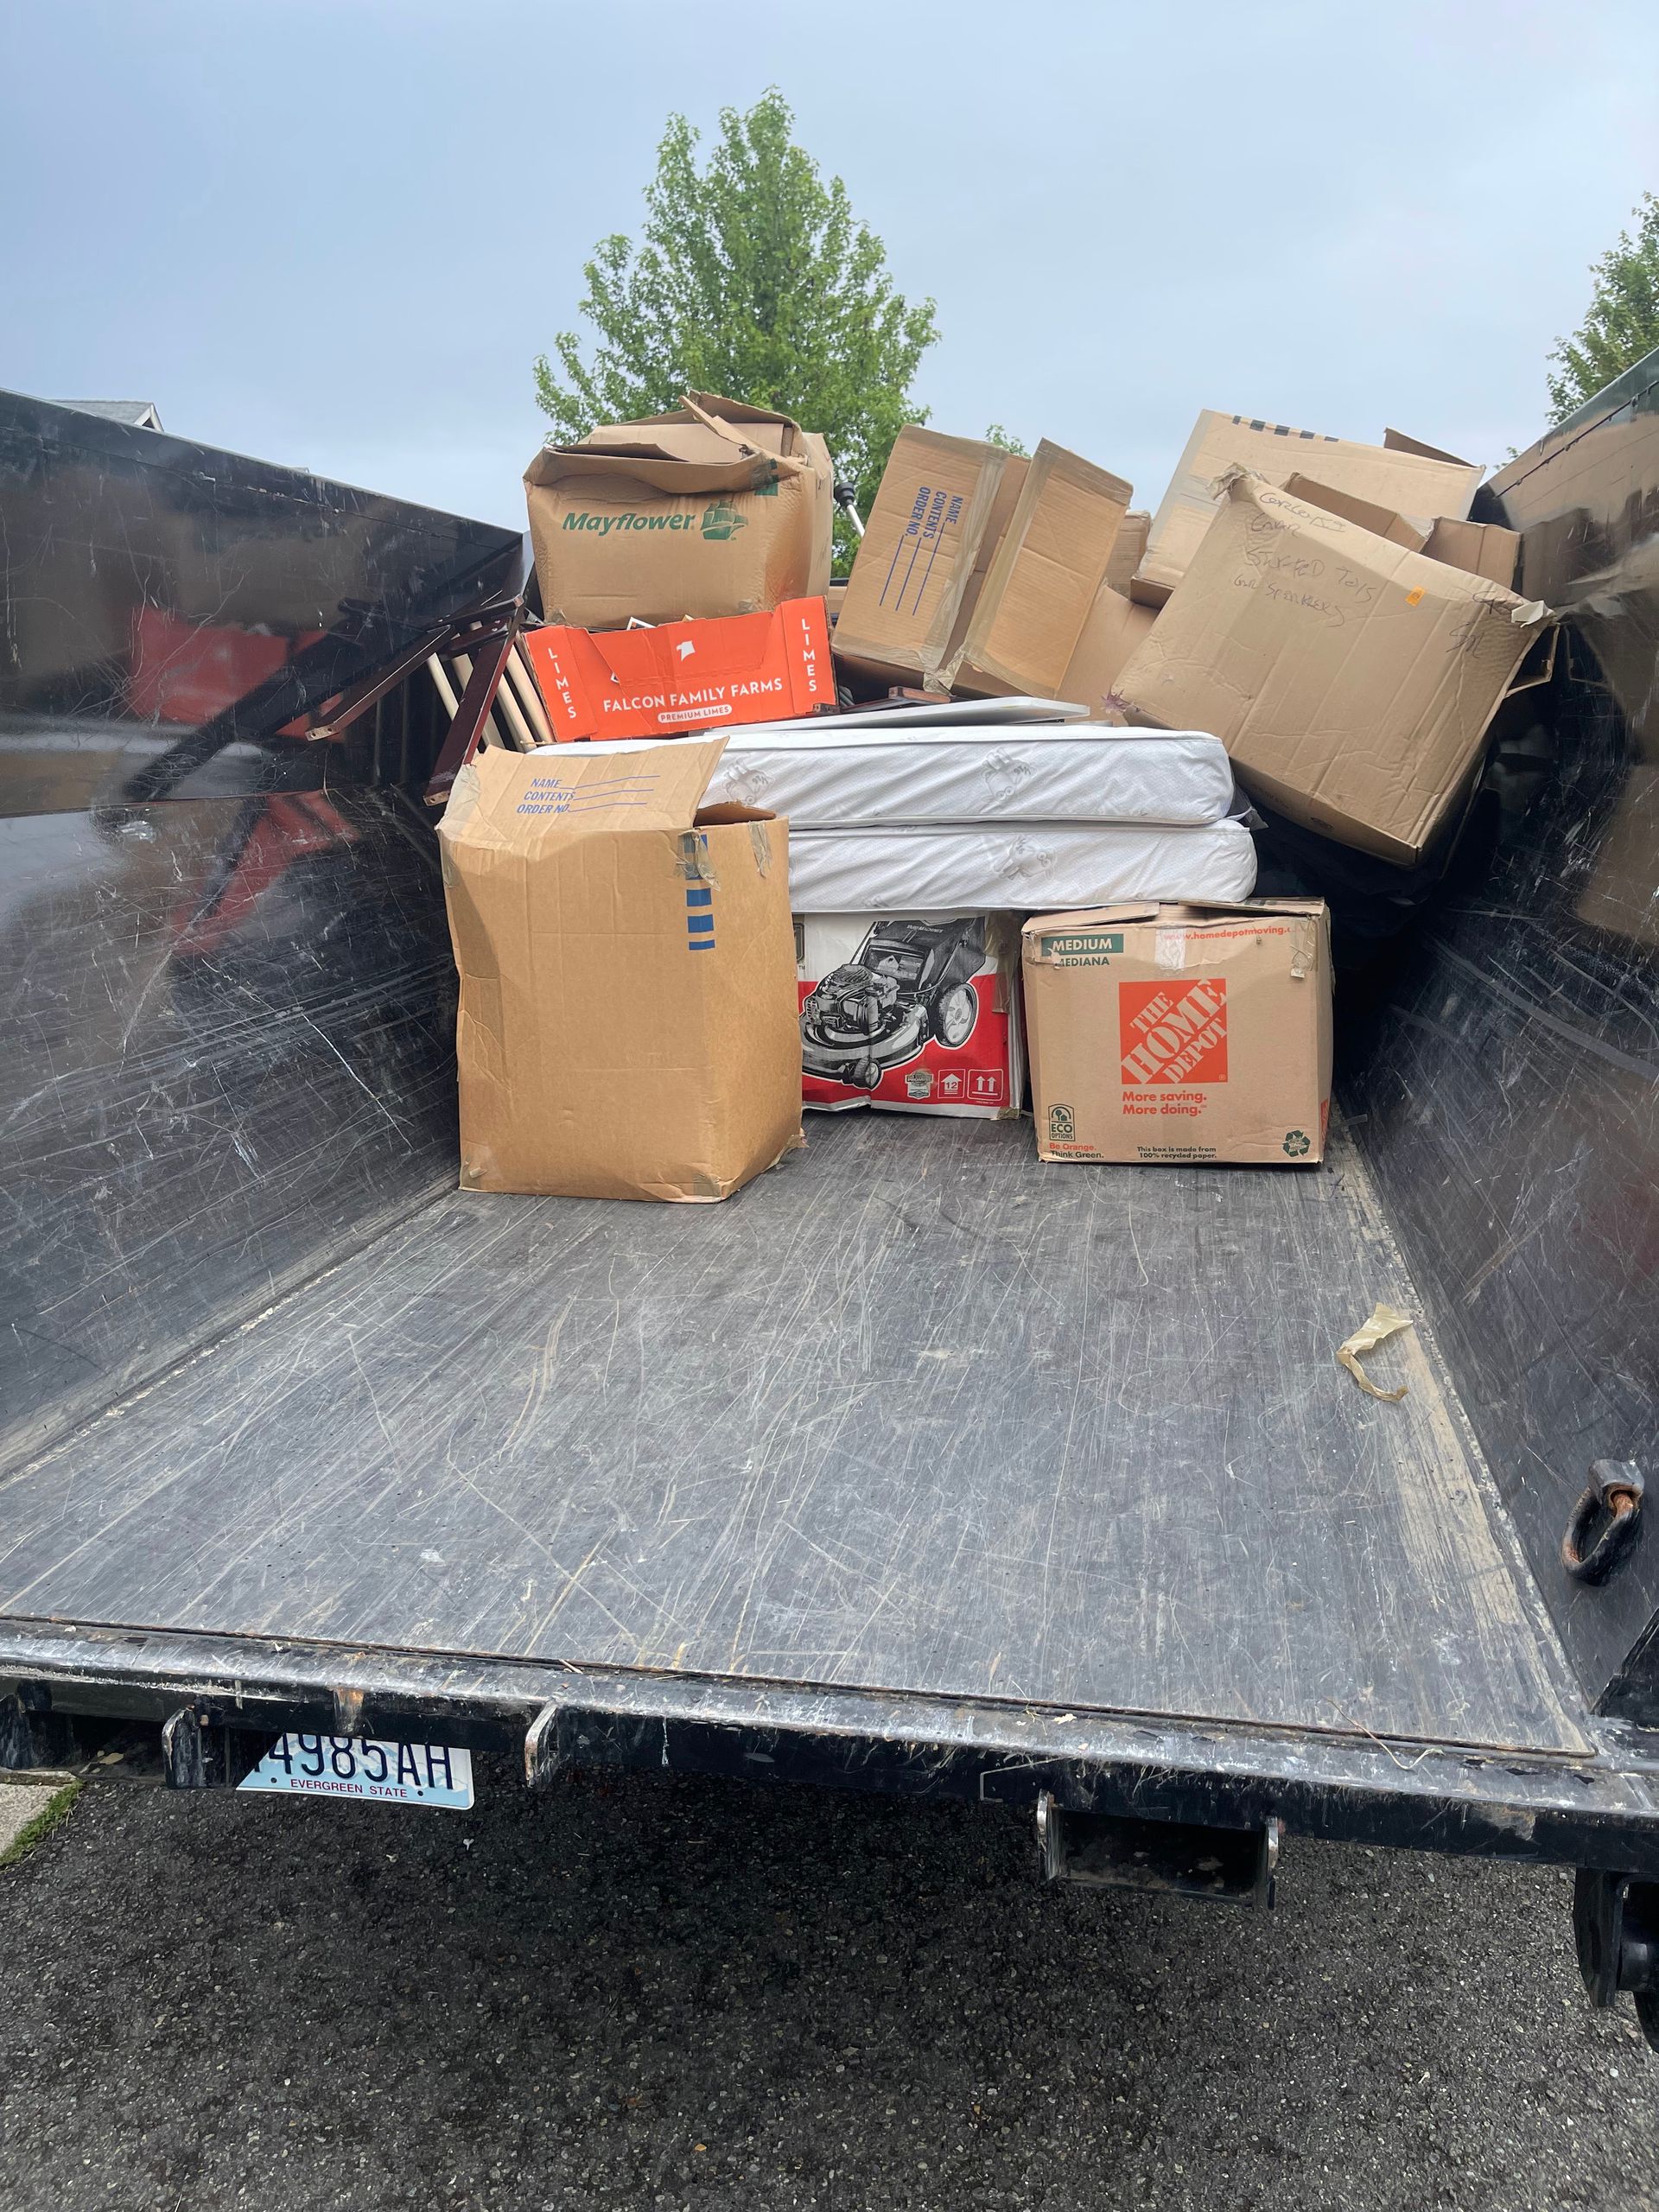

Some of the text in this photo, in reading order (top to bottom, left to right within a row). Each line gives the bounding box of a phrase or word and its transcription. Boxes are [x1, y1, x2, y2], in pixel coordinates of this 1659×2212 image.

[905, 486, 931, 537] ORDER NO.
[923, 491, 947, 539] CONTENTS
[944, 495, 963, 524] NAME
[563, 512, 696, 537] Mayflower
[802, 618, 817, 692] LIMES
[548, 647, 577, 719] LIMES
[603, 677, 783, 713] FALCON FAMILY FARMS
[660, 705, 730, 721] PREMIUM LIMES
[531, 779, 561, 788] NAME
[524, 791, 576, 801] CONTENTS
[517, 804, 552, 814] ORDER
[1052, 938, 1113, 951] MEDIUM
[1129, 991, 1174, 1033] THE
[1121, 979, 1227, 1084] HOME
[1161, 1017, 1227, 1084] DEPOT
[1122, 1090, 1207, 1103] More saving.
[1122, 1103, 1202, 1116] More doing.
[1051, 1123, 1073, 1133] ECO
[1063, 1143, 1097, 1152] Orange.
[290, 1778, 408, 1798] EVERGREEN STATE
